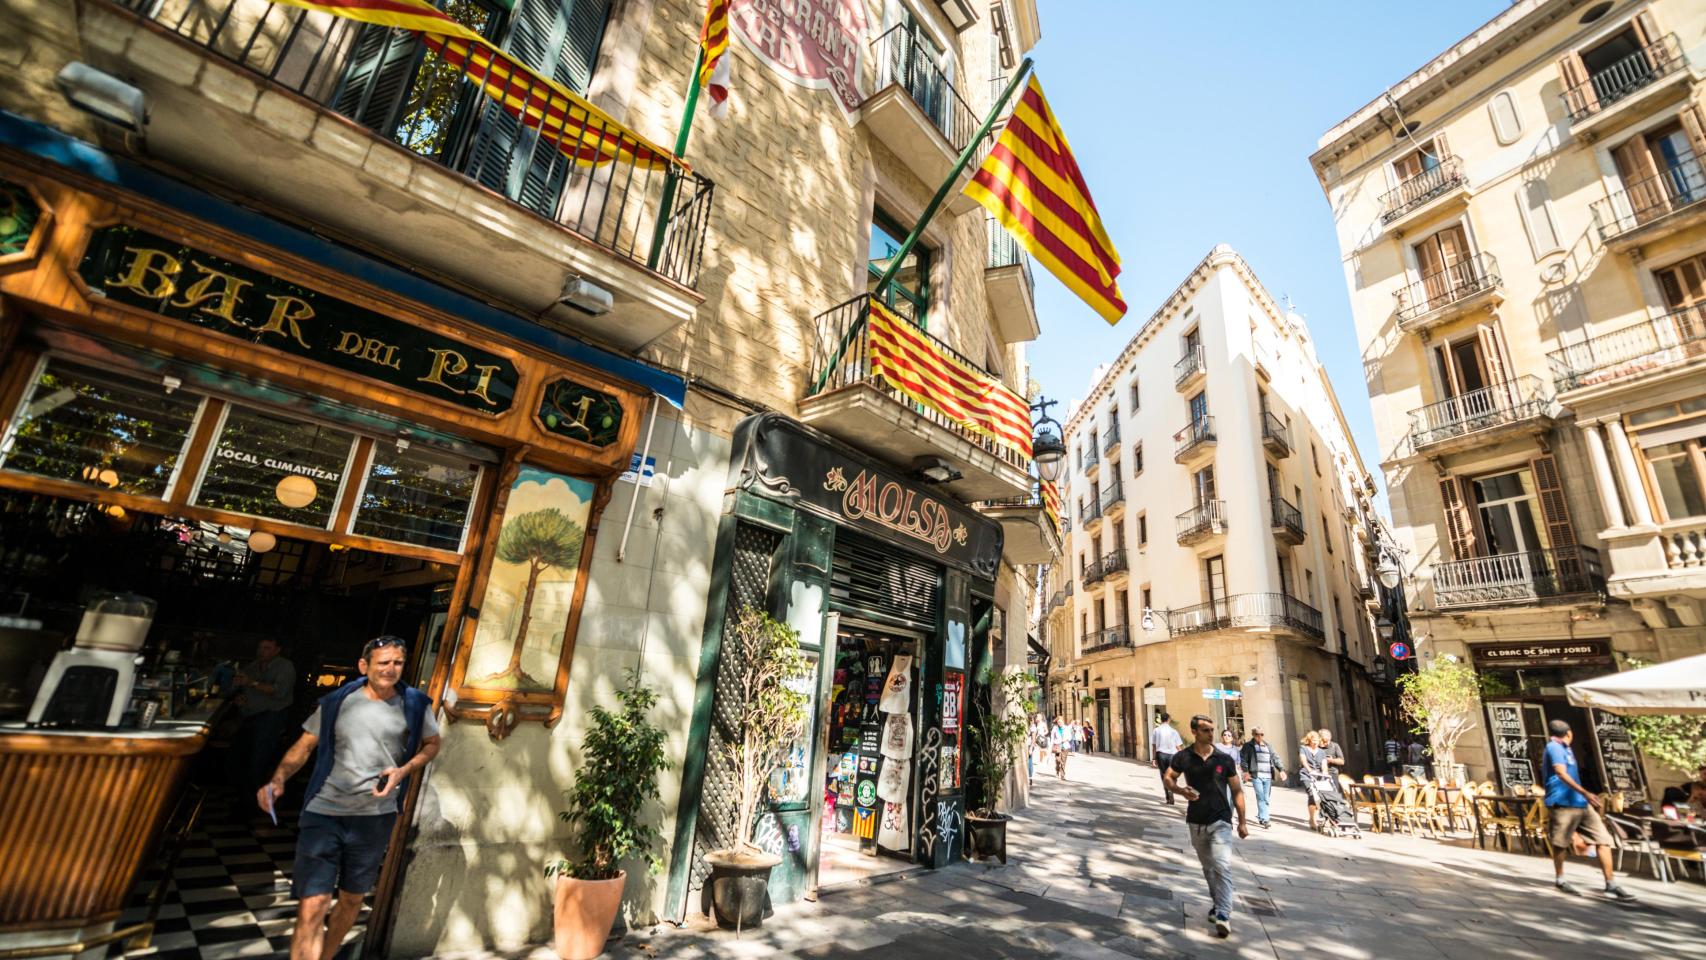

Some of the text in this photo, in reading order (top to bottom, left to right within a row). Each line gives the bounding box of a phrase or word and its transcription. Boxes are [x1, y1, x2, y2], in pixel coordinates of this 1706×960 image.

[780, 0, 856, 68] URANT
[104, 246, 501, 406] BAR DEL PI
[216, 448, 340, 482] LOCAL CLIMATITZAT
[842, 469, 952, 553] MOLSA
[1538, 647, 1561, 655] SANT
[1563, 646, 1592, 654] JORDI
